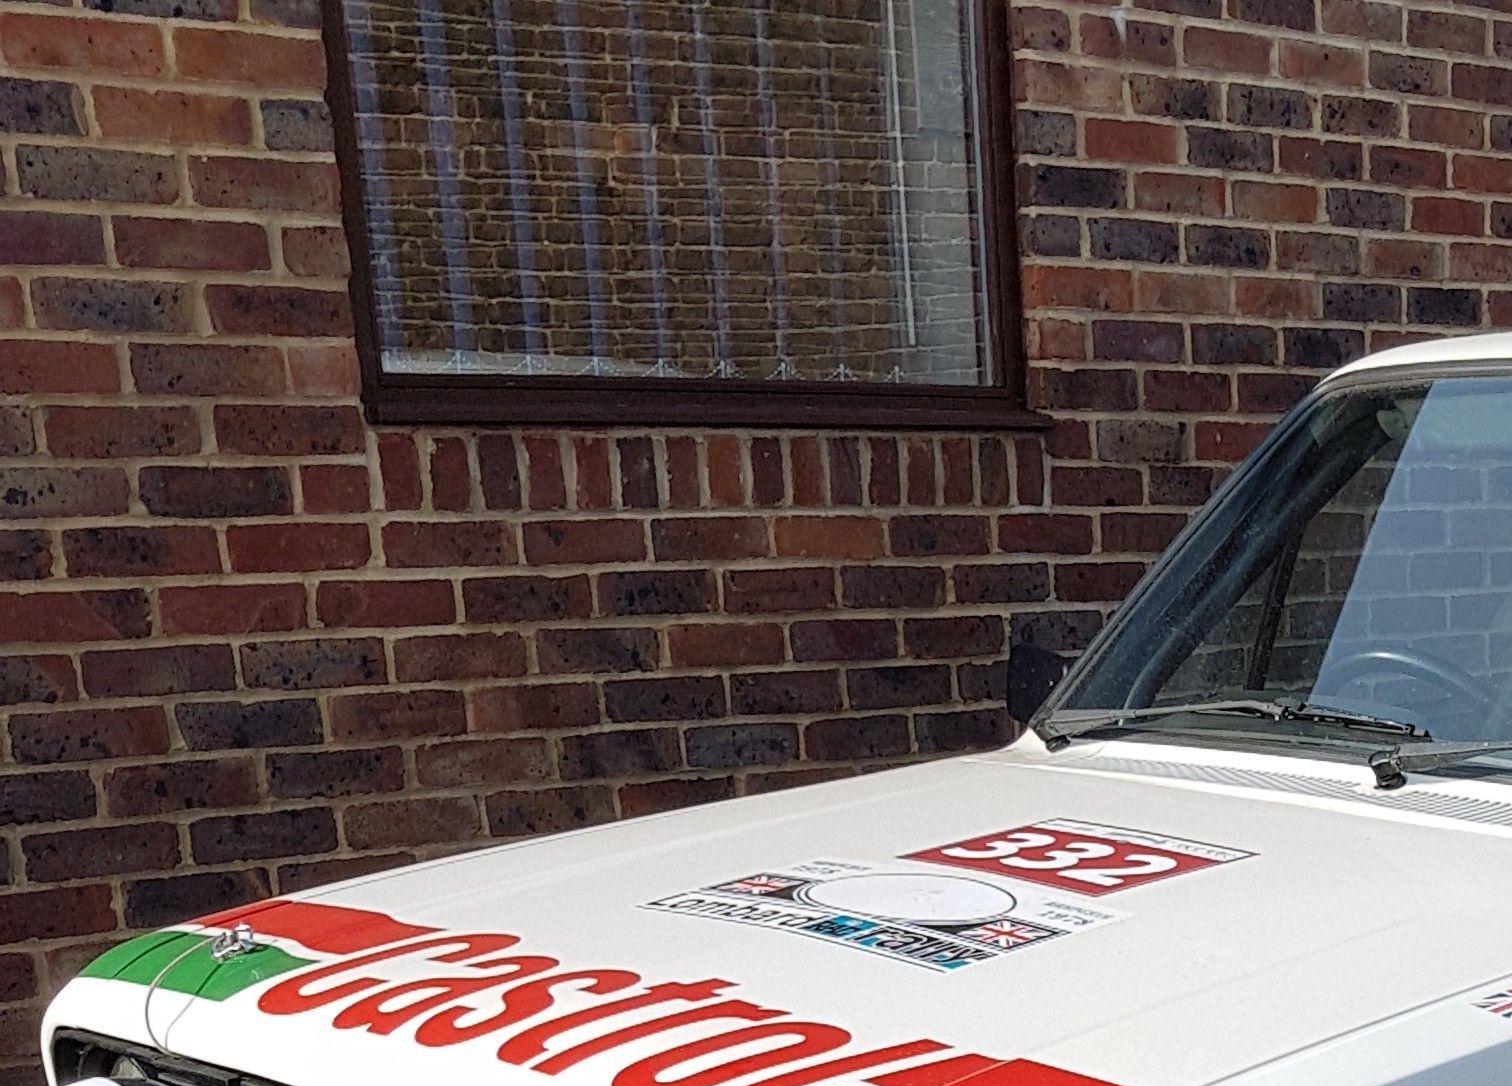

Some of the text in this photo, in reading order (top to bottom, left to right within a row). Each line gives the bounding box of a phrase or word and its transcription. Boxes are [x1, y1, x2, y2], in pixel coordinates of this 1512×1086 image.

[939, 831, 1179, 887] 332
[648, 893, 824, 931] Lombard
[855, 925, 988, 968] rally
